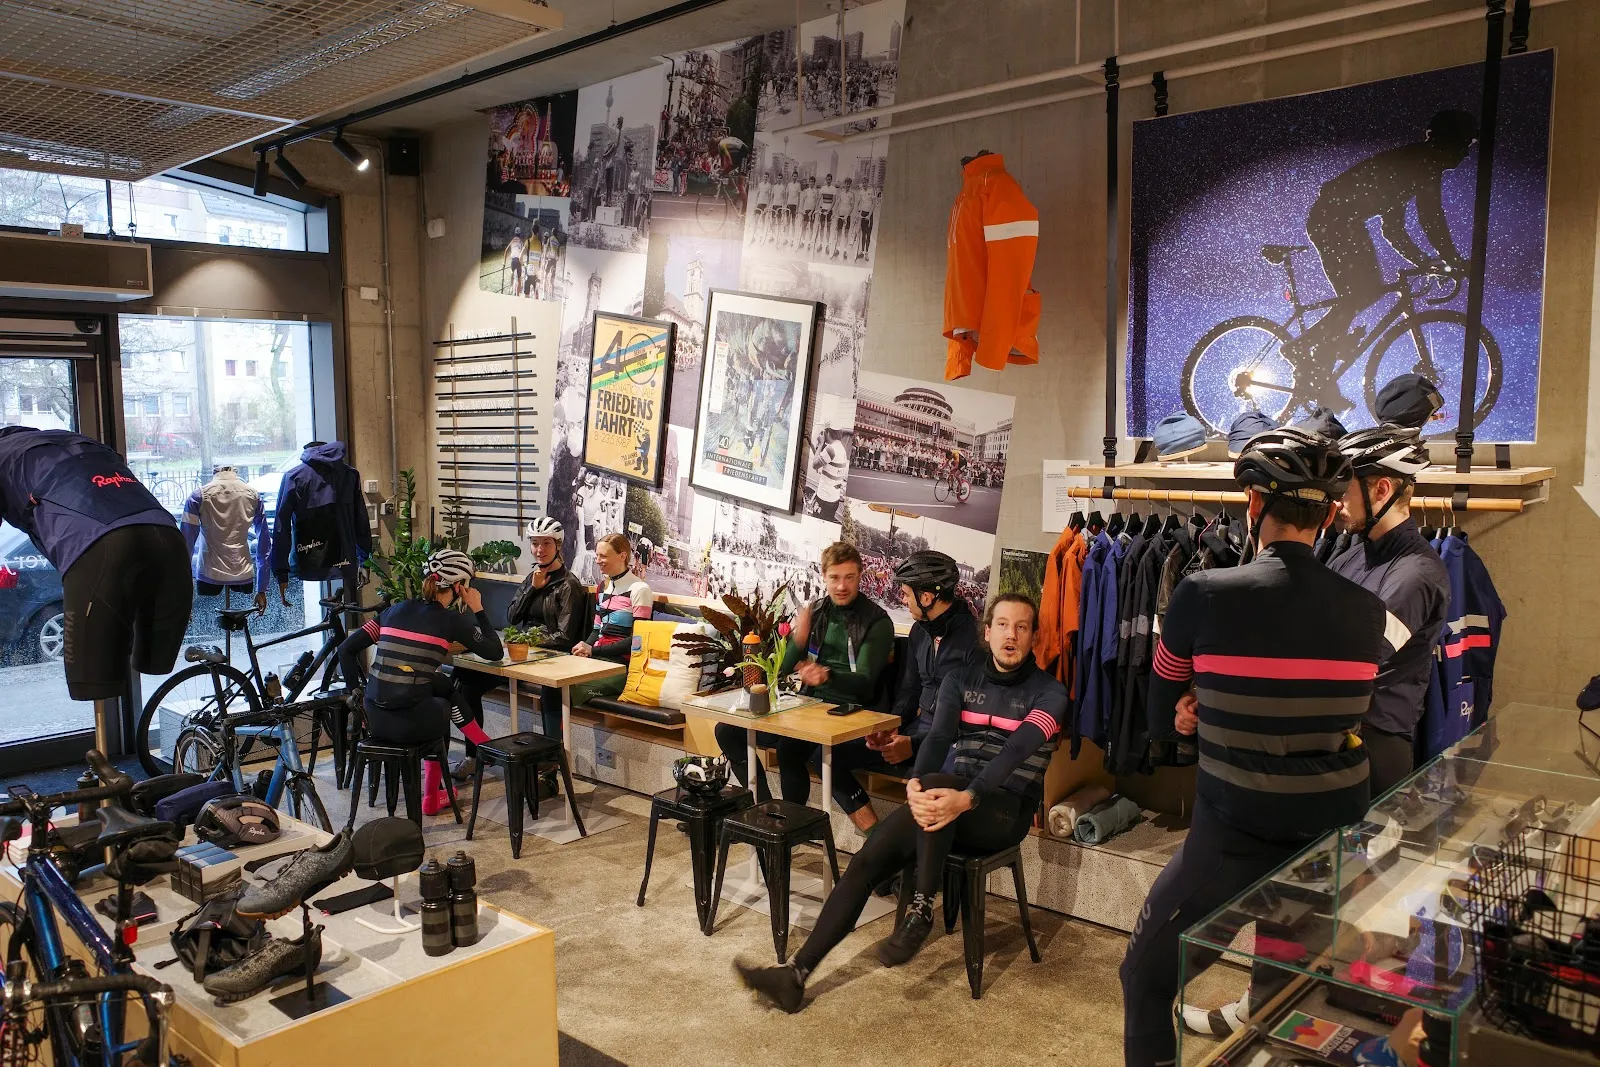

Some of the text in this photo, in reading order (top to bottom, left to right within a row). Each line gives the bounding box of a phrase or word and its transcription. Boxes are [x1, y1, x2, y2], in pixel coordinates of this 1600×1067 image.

[597, 389, 654, 421] FRIEDENS
[595, 409, 634, 438] FAHRT
[1374, 438, 1395, 451] GIRO
[706, 452, 752, 469] INTERNATIONALE
[723, 467, 766, 484] FRIEDENSFAHRT
[64, 611, 75, 664] RAPHA
[963, 690, 986, 705] RCC
